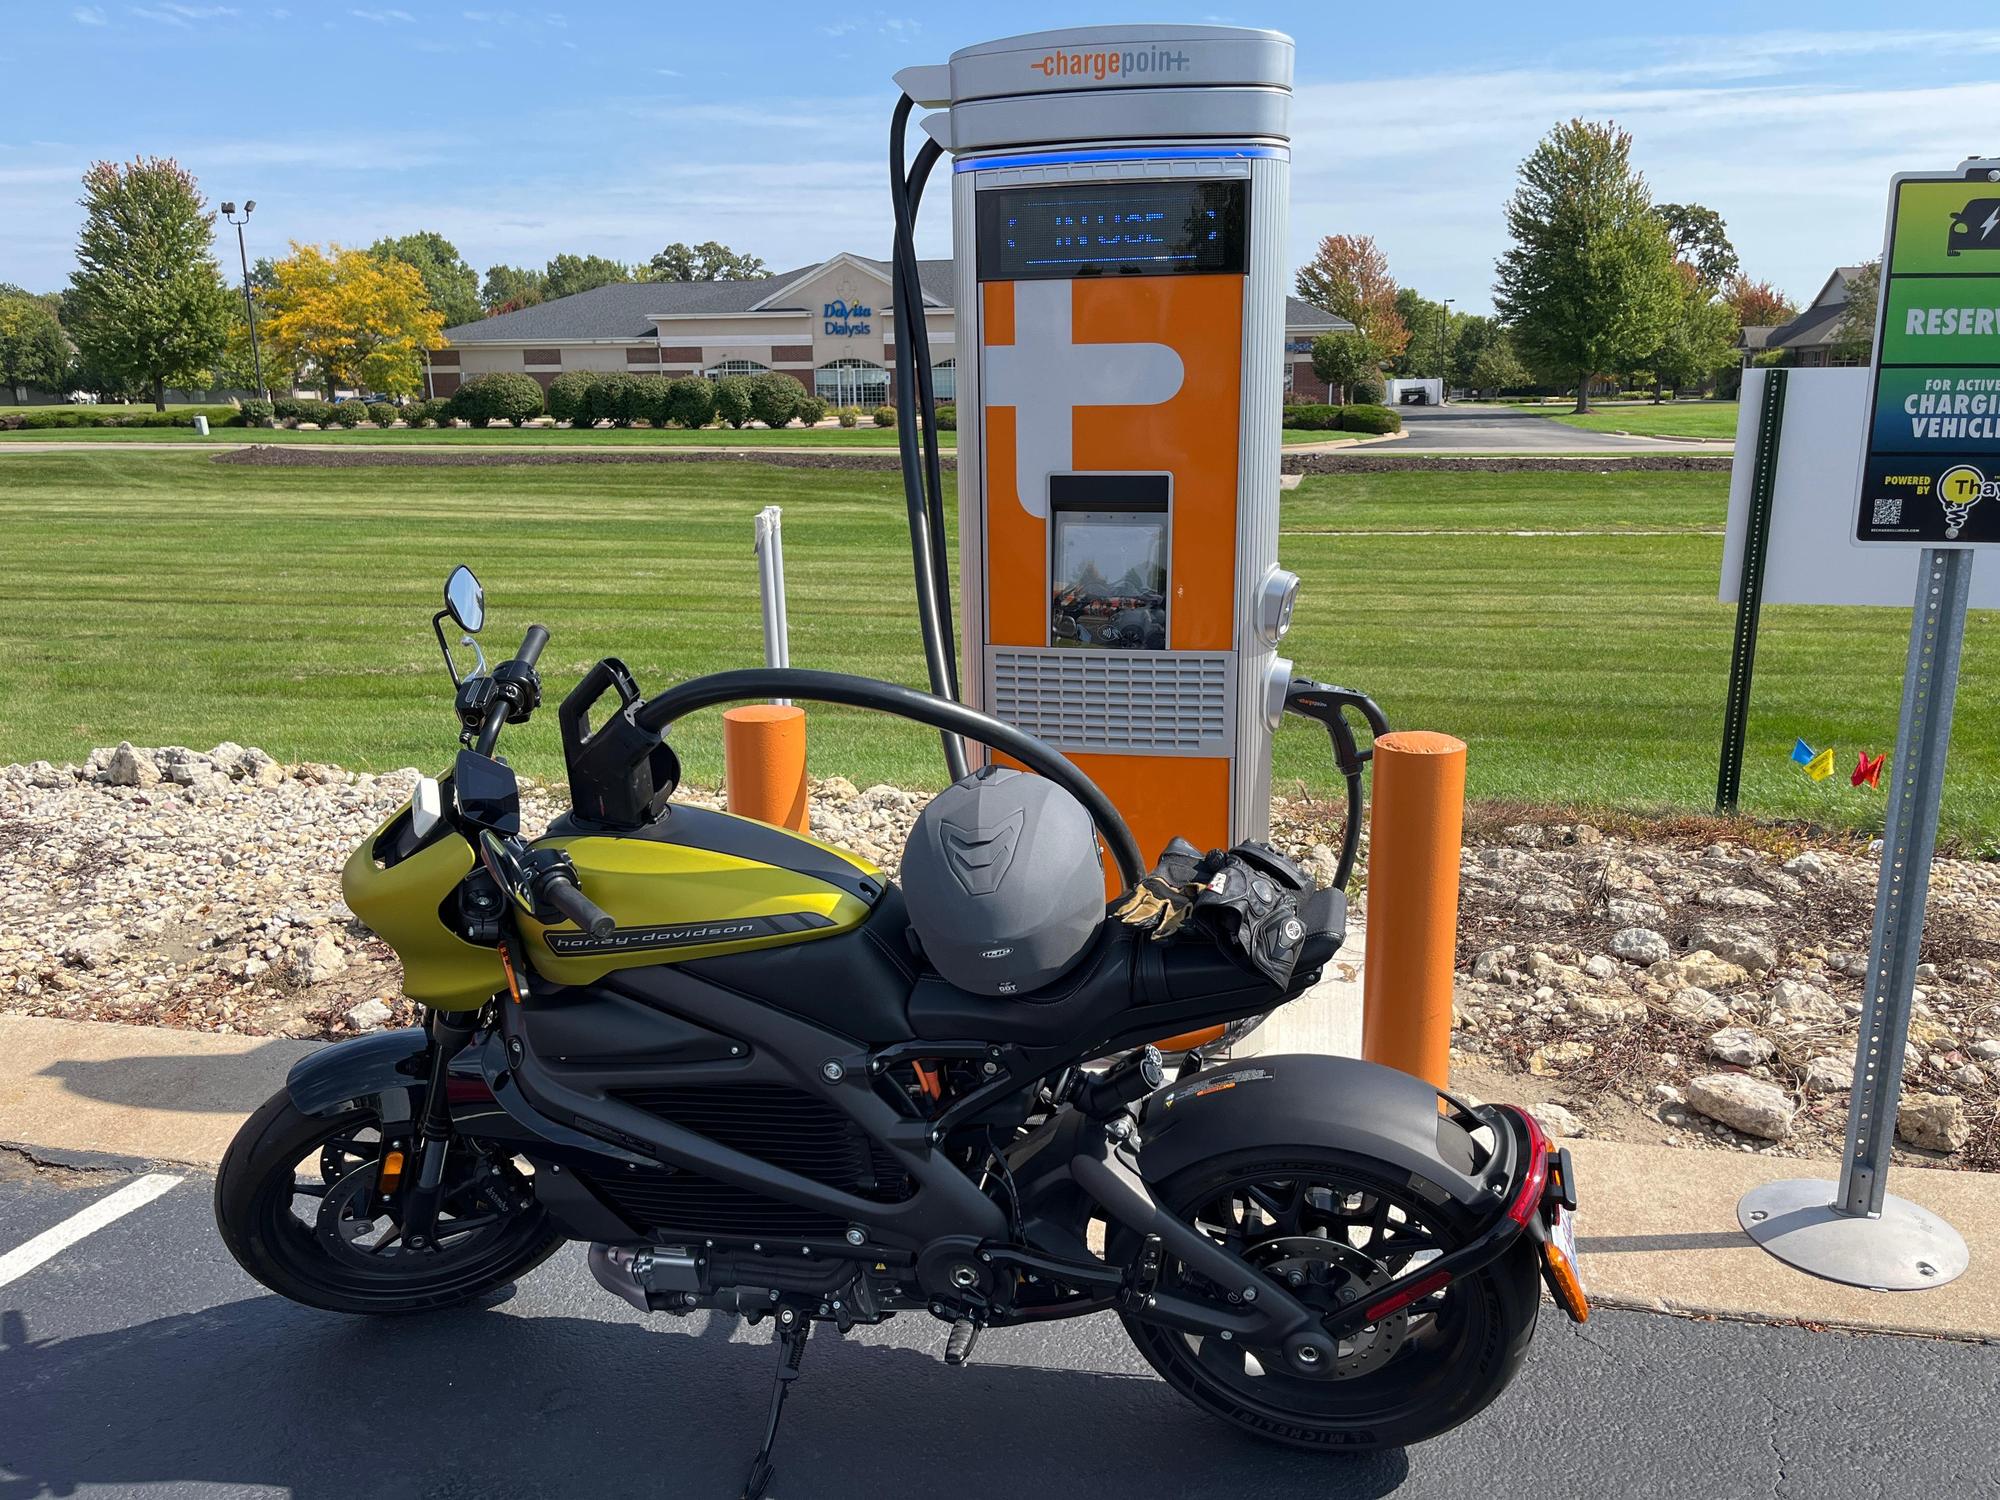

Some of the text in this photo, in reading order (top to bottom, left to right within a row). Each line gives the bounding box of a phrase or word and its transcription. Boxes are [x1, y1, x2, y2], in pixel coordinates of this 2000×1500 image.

[825, 322, 871, 337] Dialysis
[1925, 379, 1952, 391] FOR
[1904, 394, 2000, 415] CHARGI
[1884, 476, 1931, 485] POWERED
[1916, 486, 1931, 495] BY
[556, 923, 753, 948] harey-davidson
[1240, 1413, 1345, 1444] MICHELIN
